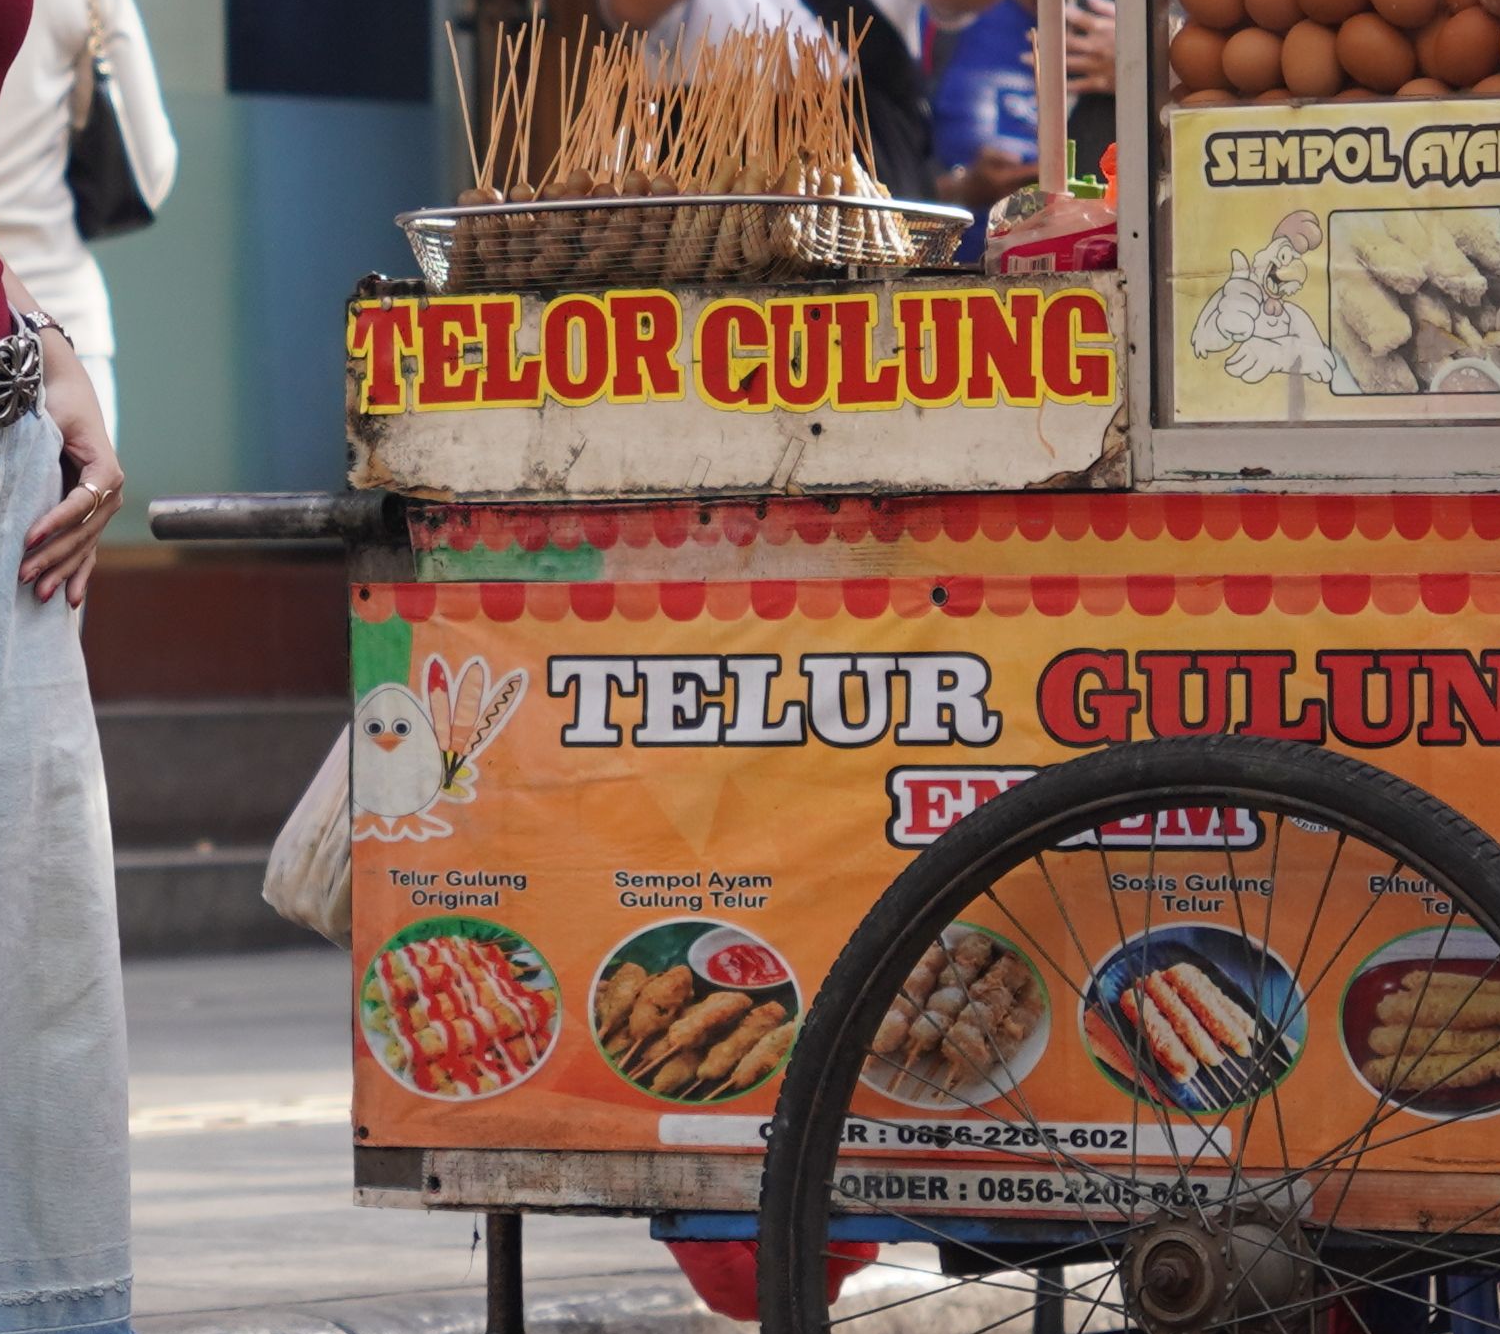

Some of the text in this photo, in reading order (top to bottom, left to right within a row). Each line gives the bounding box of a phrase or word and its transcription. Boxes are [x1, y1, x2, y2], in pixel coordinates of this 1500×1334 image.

[1205, 126, 1404, 188] SEMPOL
[350, 287, 1117, 415] TELOR GULUNG
[548, 652, 1002, 749] TELUR
[389, 869, 527, 891] Telur Gulung
[615, 870, 773, 892] Sempol Ayam
[1111, 873, 1274, 898] Sosis Gulung
[411, 889, 500, 909] Original
[619, 891, 770, 912] Gulung Telur
[1161, 895, 1225, 914] Telur
[897, 1126, 1129, 1150] 0856-2205-602
[840, 1175, 949, 1201] ORDER
